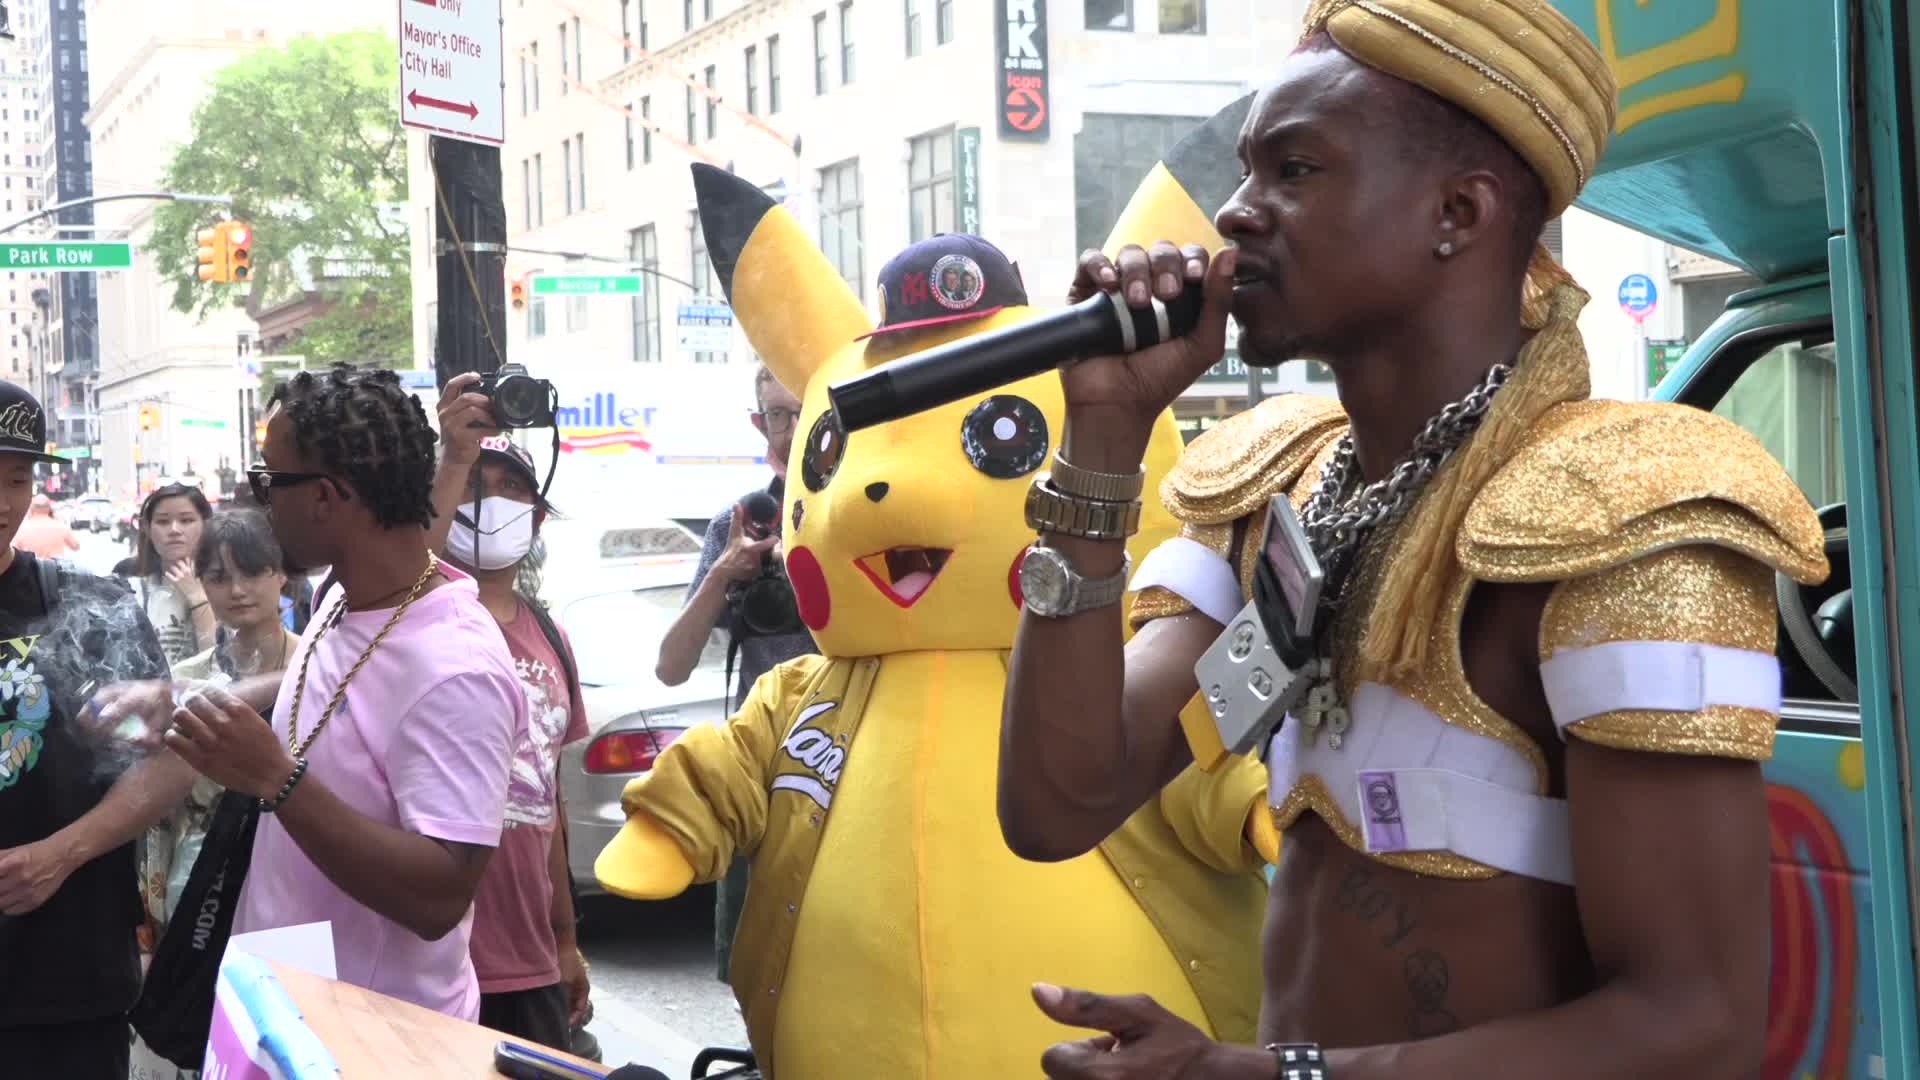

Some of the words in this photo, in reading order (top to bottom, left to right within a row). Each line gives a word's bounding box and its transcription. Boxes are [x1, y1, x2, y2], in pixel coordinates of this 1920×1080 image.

[404, 21, 448, 50] Mayor's
[450, 33, 482, 58] Office
[405, 51, 428, 78] City
[431, 57, 452, 80] Hall
[1007, 71, 1042, 89] icon
[8, 247, 49, 265] Park
[55, 247, 94, 265] Row
[1227, 358, 1273, 376] BAK
[555, 392, 657, 427] miller
